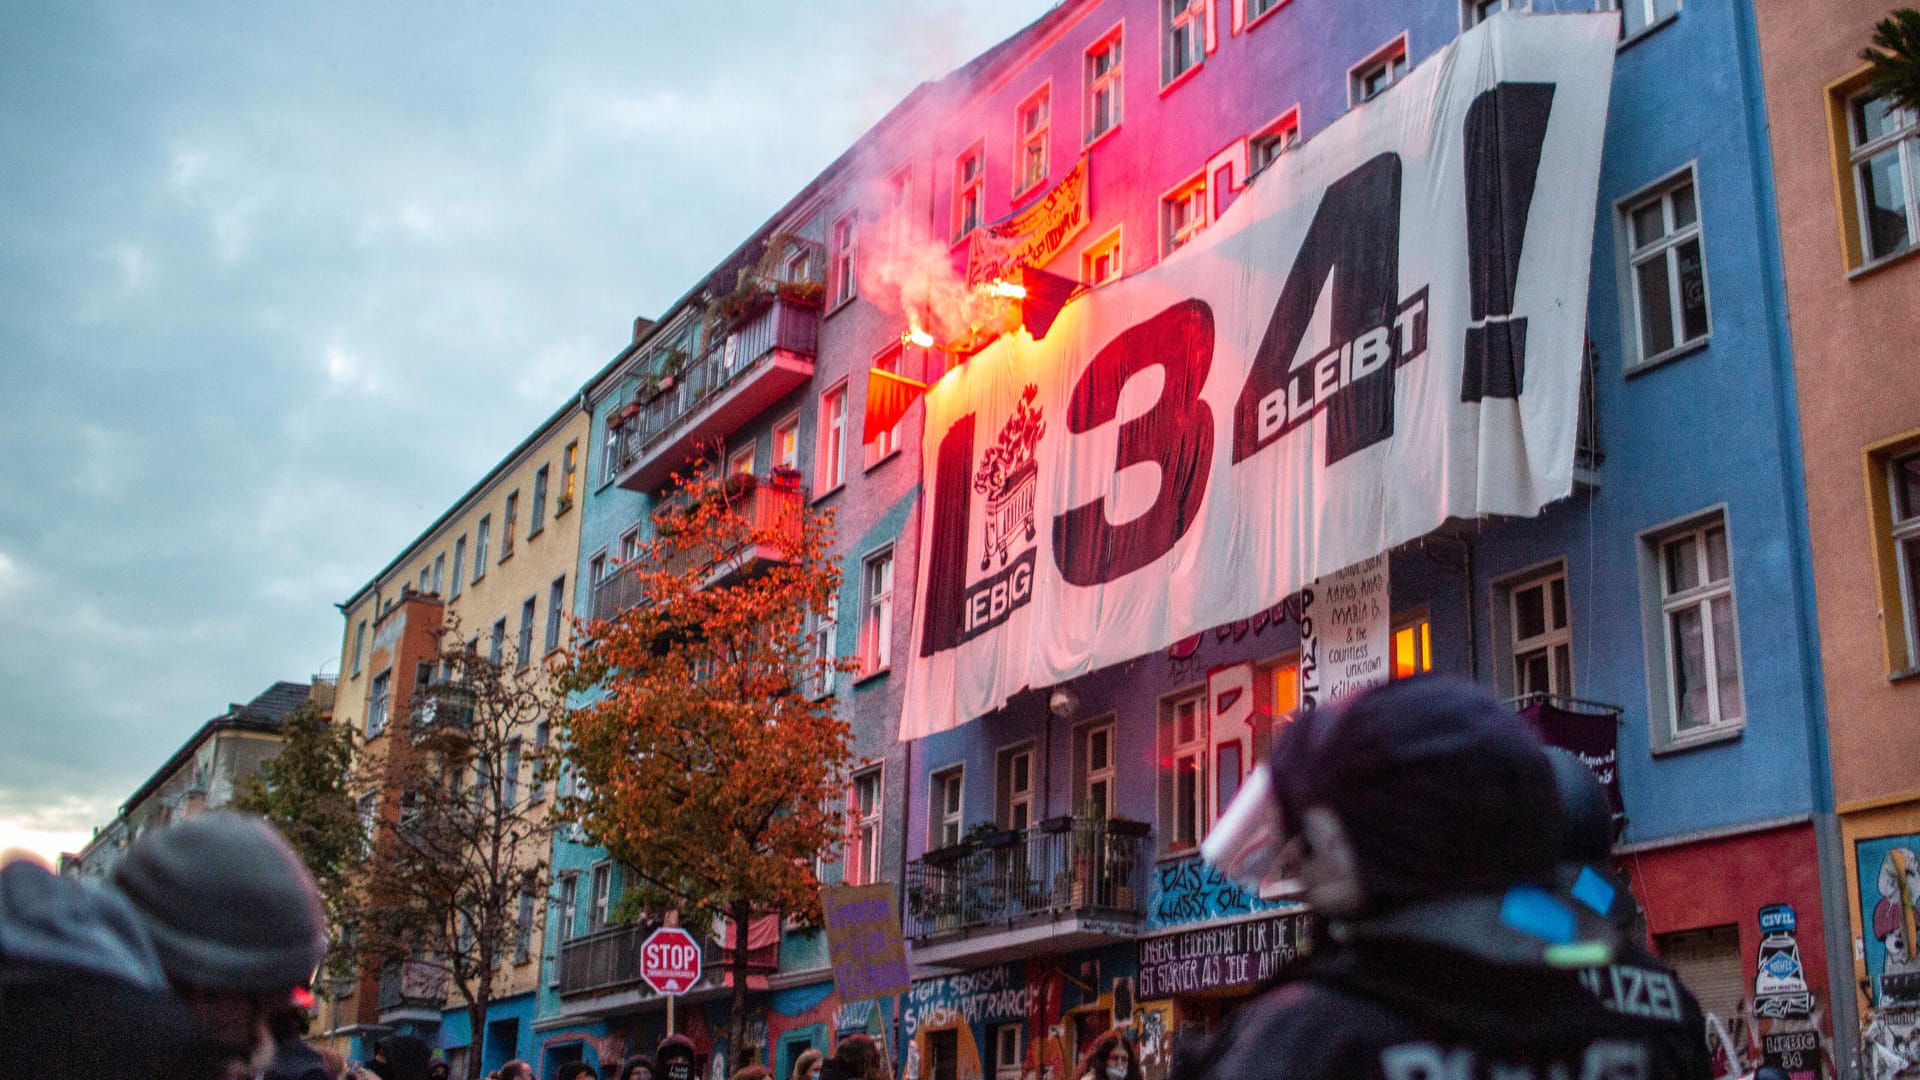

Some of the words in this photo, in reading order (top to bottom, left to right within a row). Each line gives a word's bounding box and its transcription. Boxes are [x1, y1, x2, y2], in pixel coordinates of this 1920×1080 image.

[1257, 299, 1425, 436] BLEIBT
[1761, 913, 1795, 928] CIVIL
[646, 943, 696, 971] STOP
[1139, 935, 1177, 966] UNSERE
[1180, 924, 1242, 960] LEIDENSCHAFT
[1246, 921, 1268, 952] FÜR
[907, 979, 945, 1003] FIGHT
[949, 967, 1010, 997] SEXISM!
[1139, 965, 1156, 998] IST
[1201, 955, 1221, 987] ALS
[1225, 953, 1249, 985] JEDE
[904, 998, 960, 1035] SMASH
